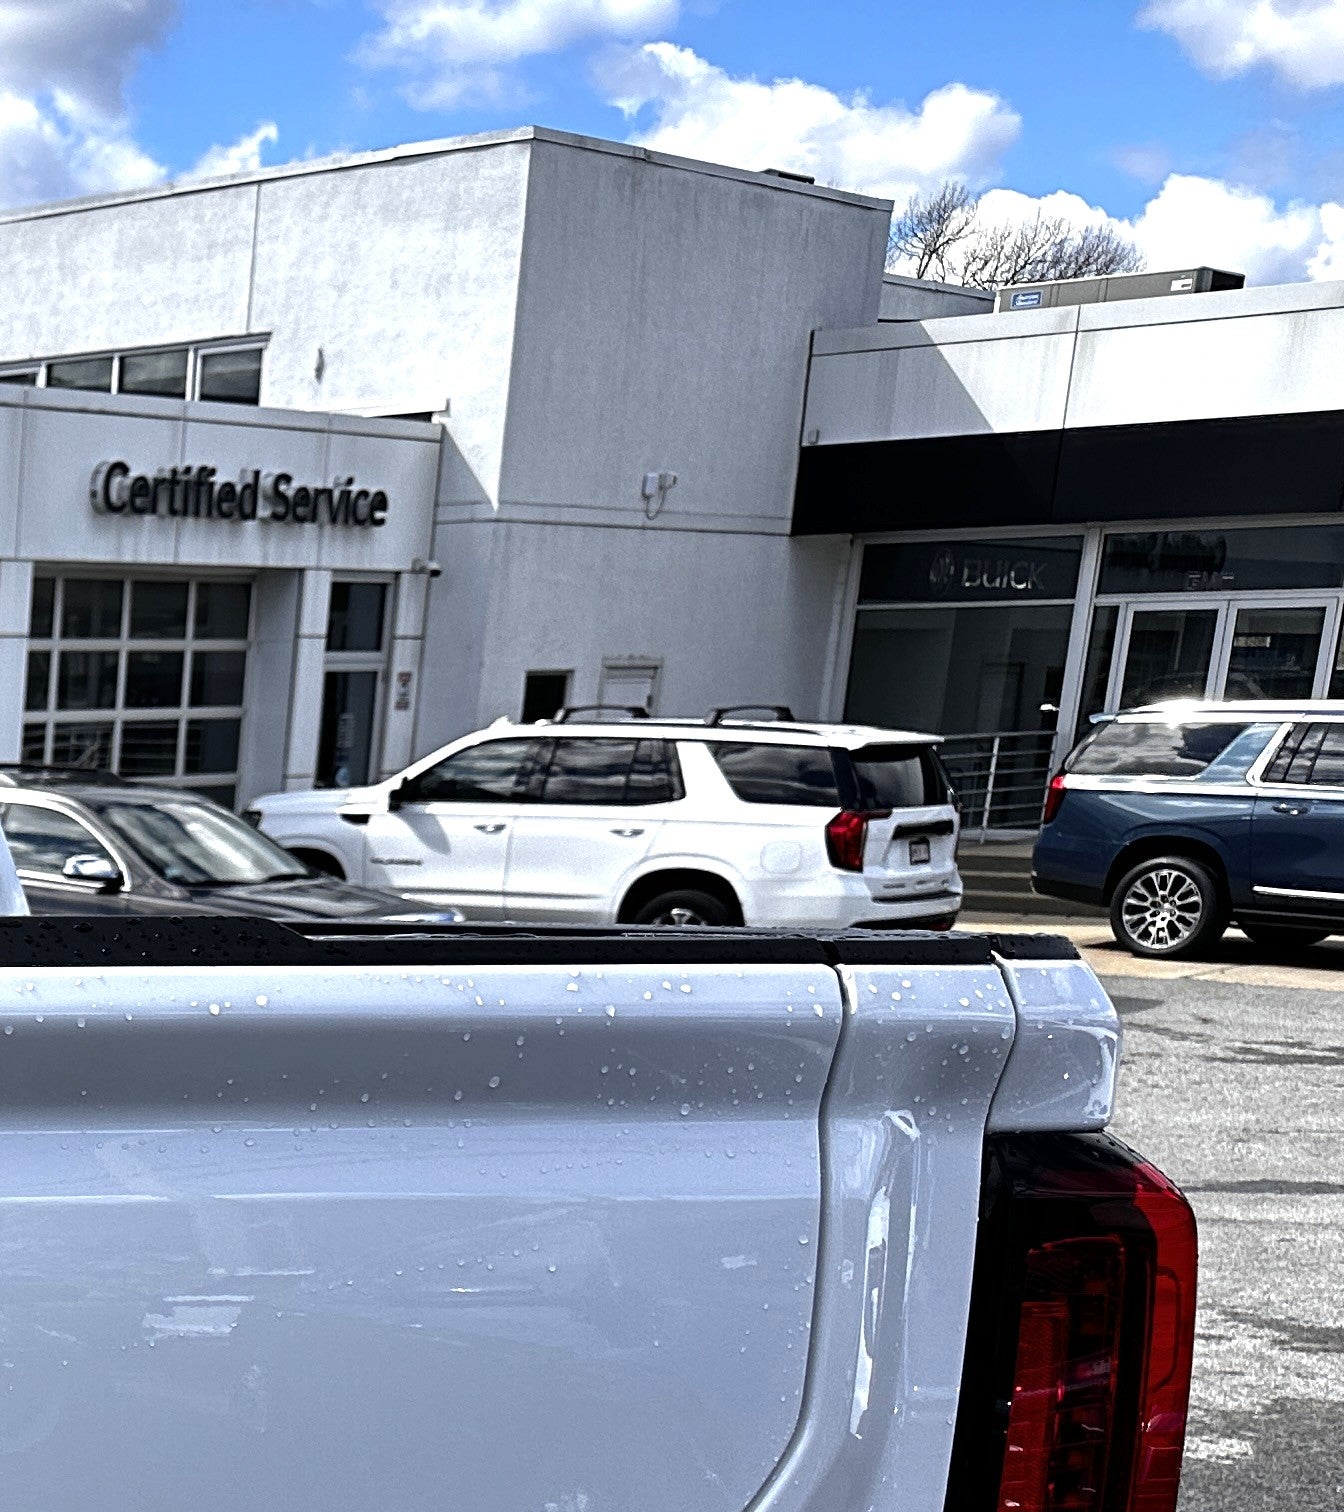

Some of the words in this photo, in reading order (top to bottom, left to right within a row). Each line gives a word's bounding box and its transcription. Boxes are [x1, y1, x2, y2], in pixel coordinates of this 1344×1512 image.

[100, 460, 261, 520] Certified
[270, 471, 389, 527] Service
[962, 559, 1048, 590] BUICK
